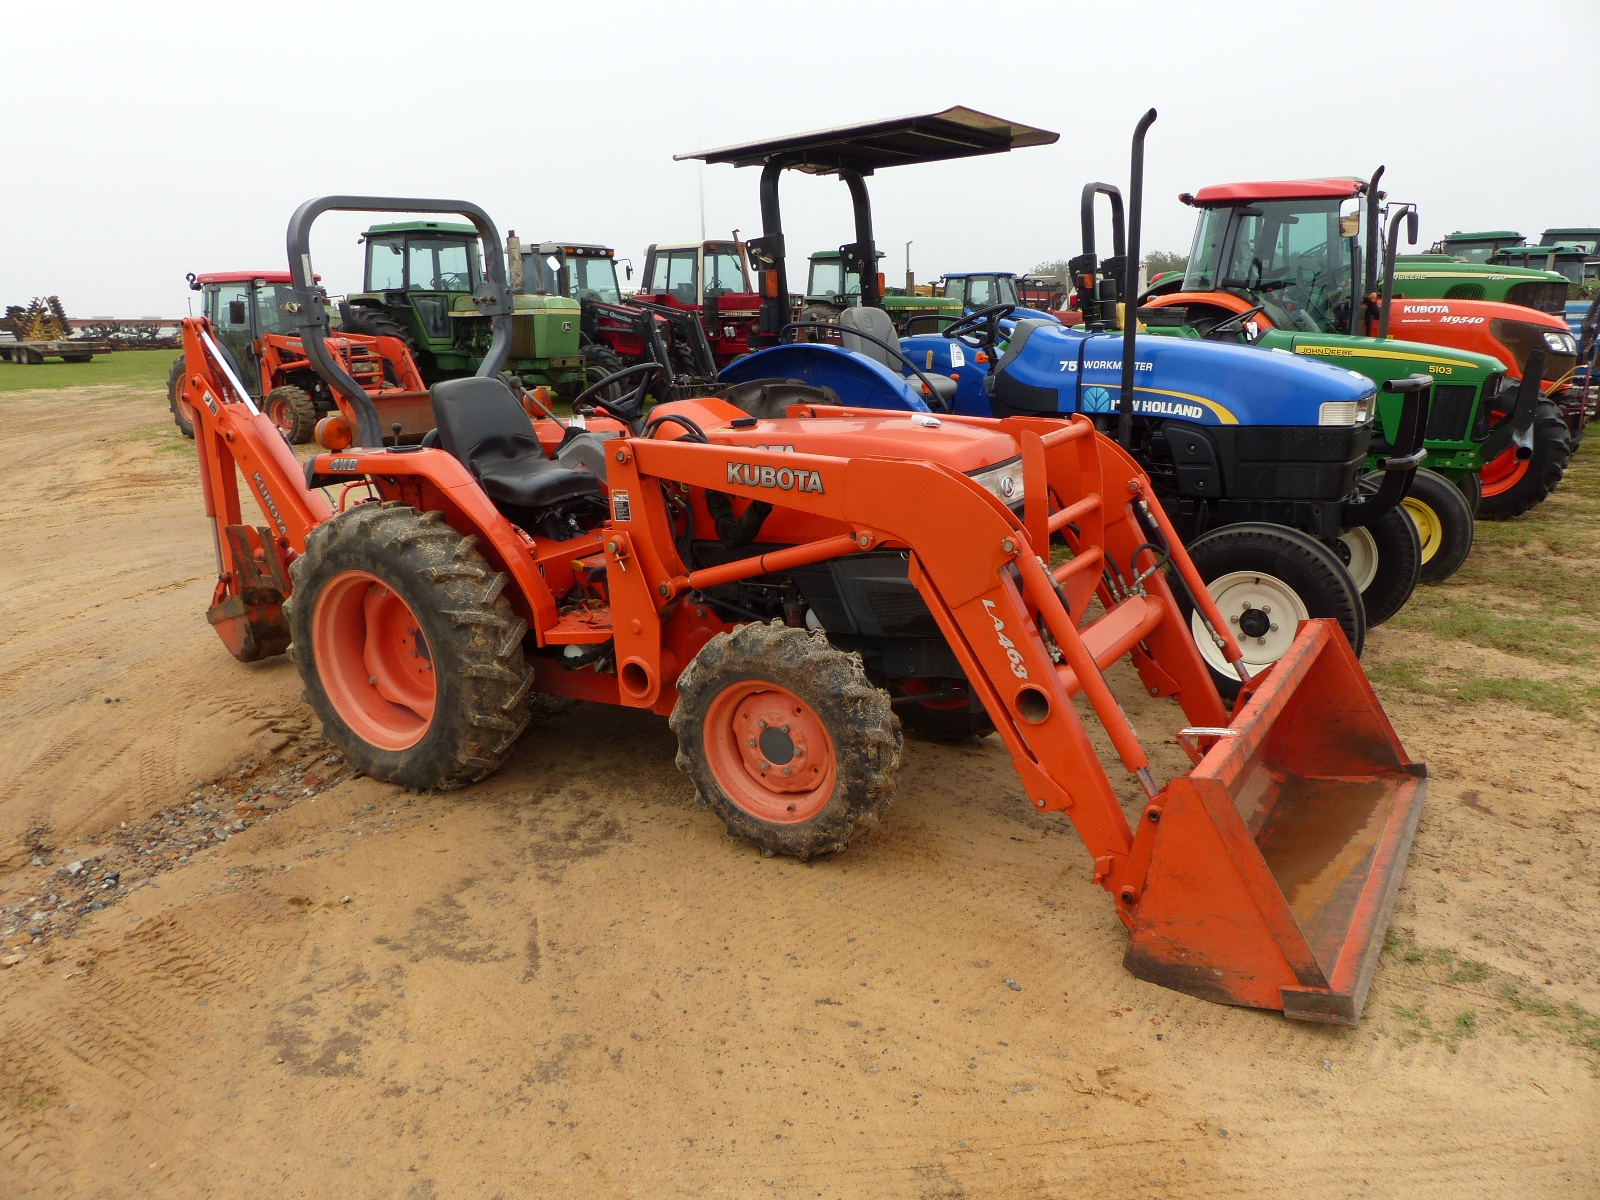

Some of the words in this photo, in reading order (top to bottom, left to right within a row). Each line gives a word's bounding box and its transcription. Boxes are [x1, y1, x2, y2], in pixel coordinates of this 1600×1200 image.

[1403, 305, 1449, 314] KUBOTA
[1439, 316, 1484, 324] M9540
[1301, 346, 1324, 355] JOHN
[1324, 347, 1353, 356] DEERE
[1059, 360, 1078, 372] 75
[1083, 360, 1153, 372] WORKMTER
[1428, 365, 1453, 375] 5103
[1141, 400, 1203, 419] HOLLAND
[329, 458, 359, 471] 4WD
[727, 462, 825, 494] KUBOTA
[252, 471, 288, 536] KUBOTA
[981, 599, 1029, 679] LA463
